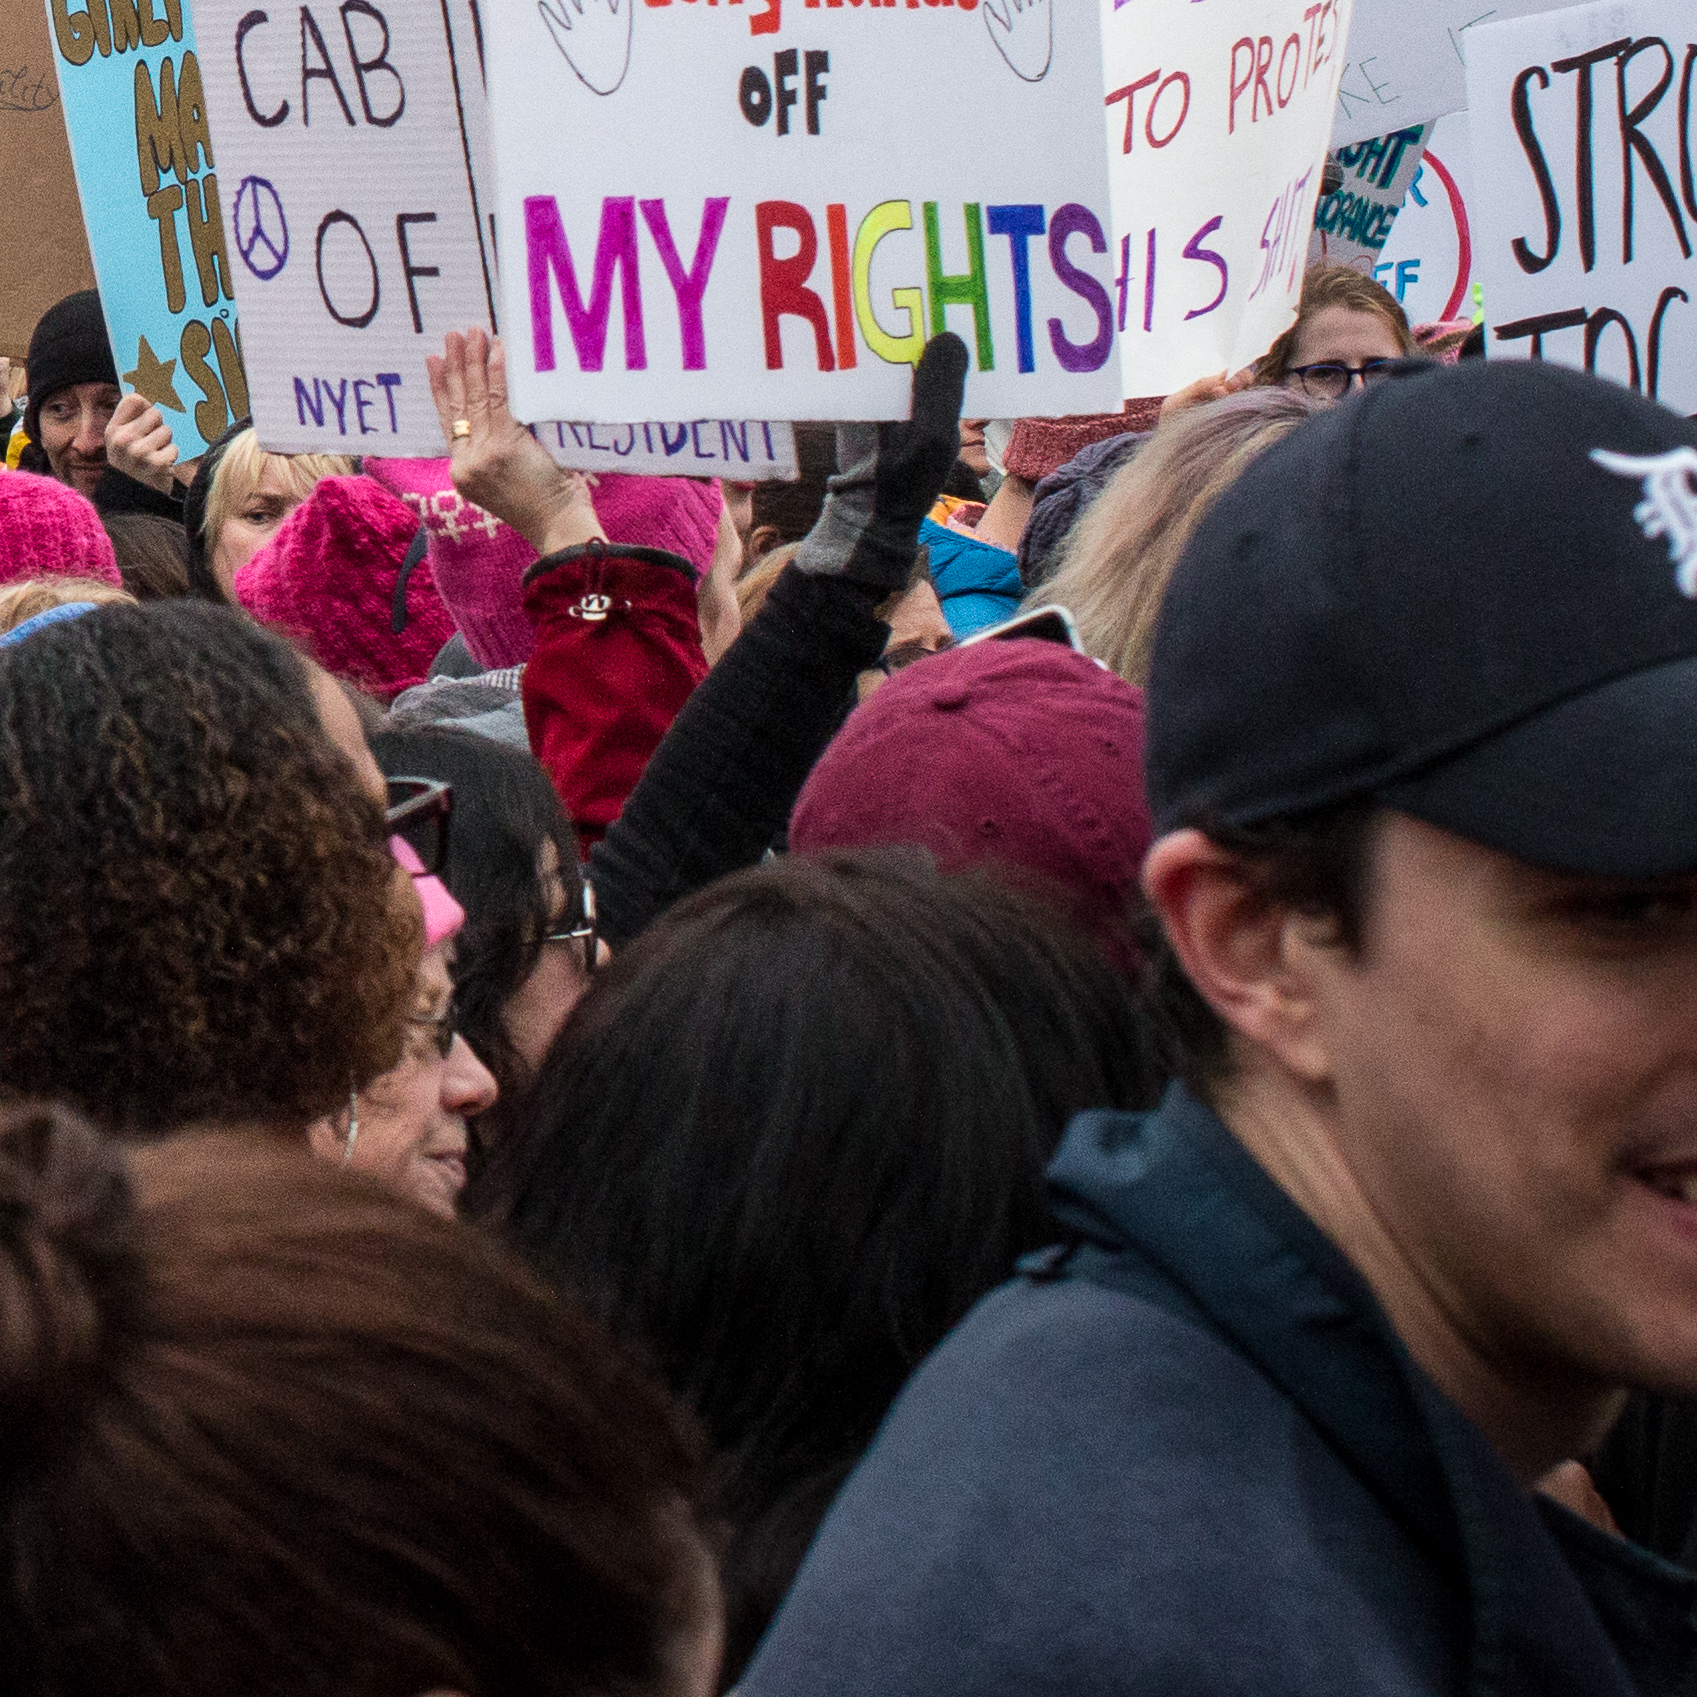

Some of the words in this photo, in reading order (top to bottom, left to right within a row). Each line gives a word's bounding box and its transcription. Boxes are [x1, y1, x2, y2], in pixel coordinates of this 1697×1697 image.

[1105, 69, 1191, 155] TO
[315, 208, 441, 335] OF
[524, 195, 730, 372] MY
[755, 199, 1114, 374] RIGHTS
[293, 374, 403, 437] NYET
[527, 418, 776, 463] RESIDENT
